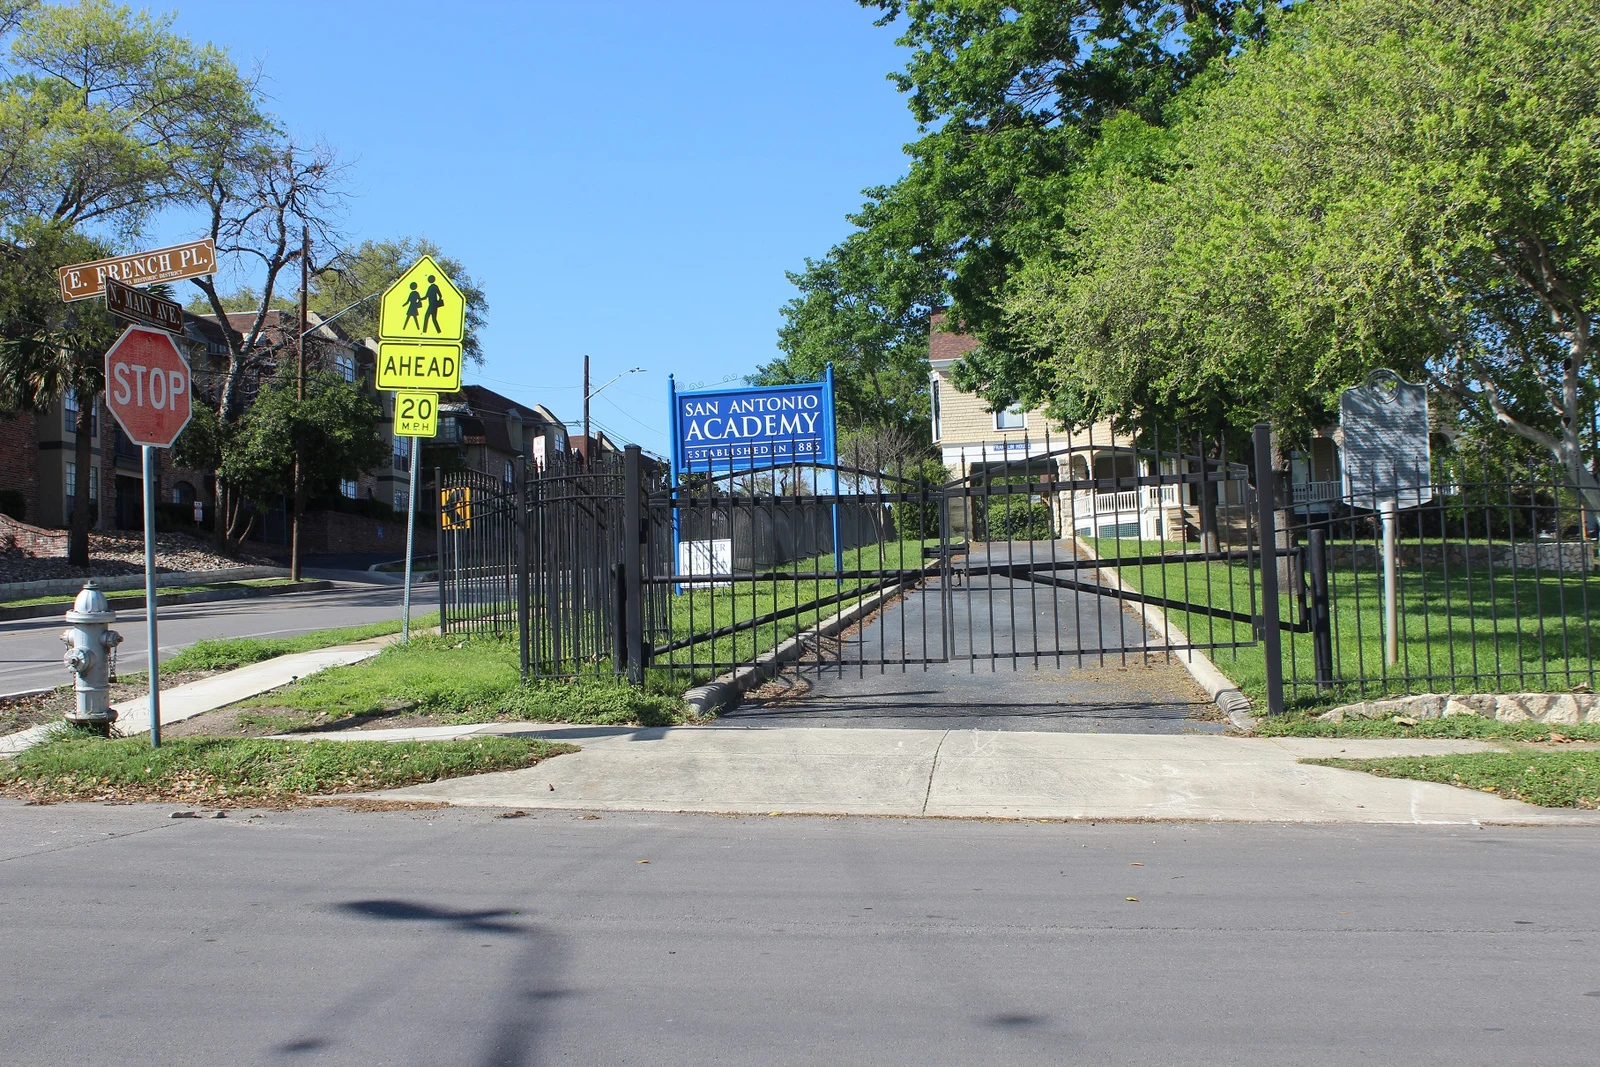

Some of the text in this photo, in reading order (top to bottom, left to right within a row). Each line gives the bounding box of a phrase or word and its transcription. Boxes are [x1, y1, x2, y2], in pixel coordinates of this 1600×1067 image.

[69, 247, 208, 289] E. FRENCH PL.
[110, 283, 120, 304] N.
[124, 289, 152, 315] MAIN
[157, 302, 180, 325] AVE.
[384, 355, 454, 377] AHEAD
[113, 362, 185, 411] STOP
[401, 398, 432, 420] 20
[685, 394, 818, 417] SAN ANTONIO
[685, 412, 820, 441] ACADEMY
[687, 446, 769, 459] ESTABLISHED
[773, 444, 787, 453] IN
